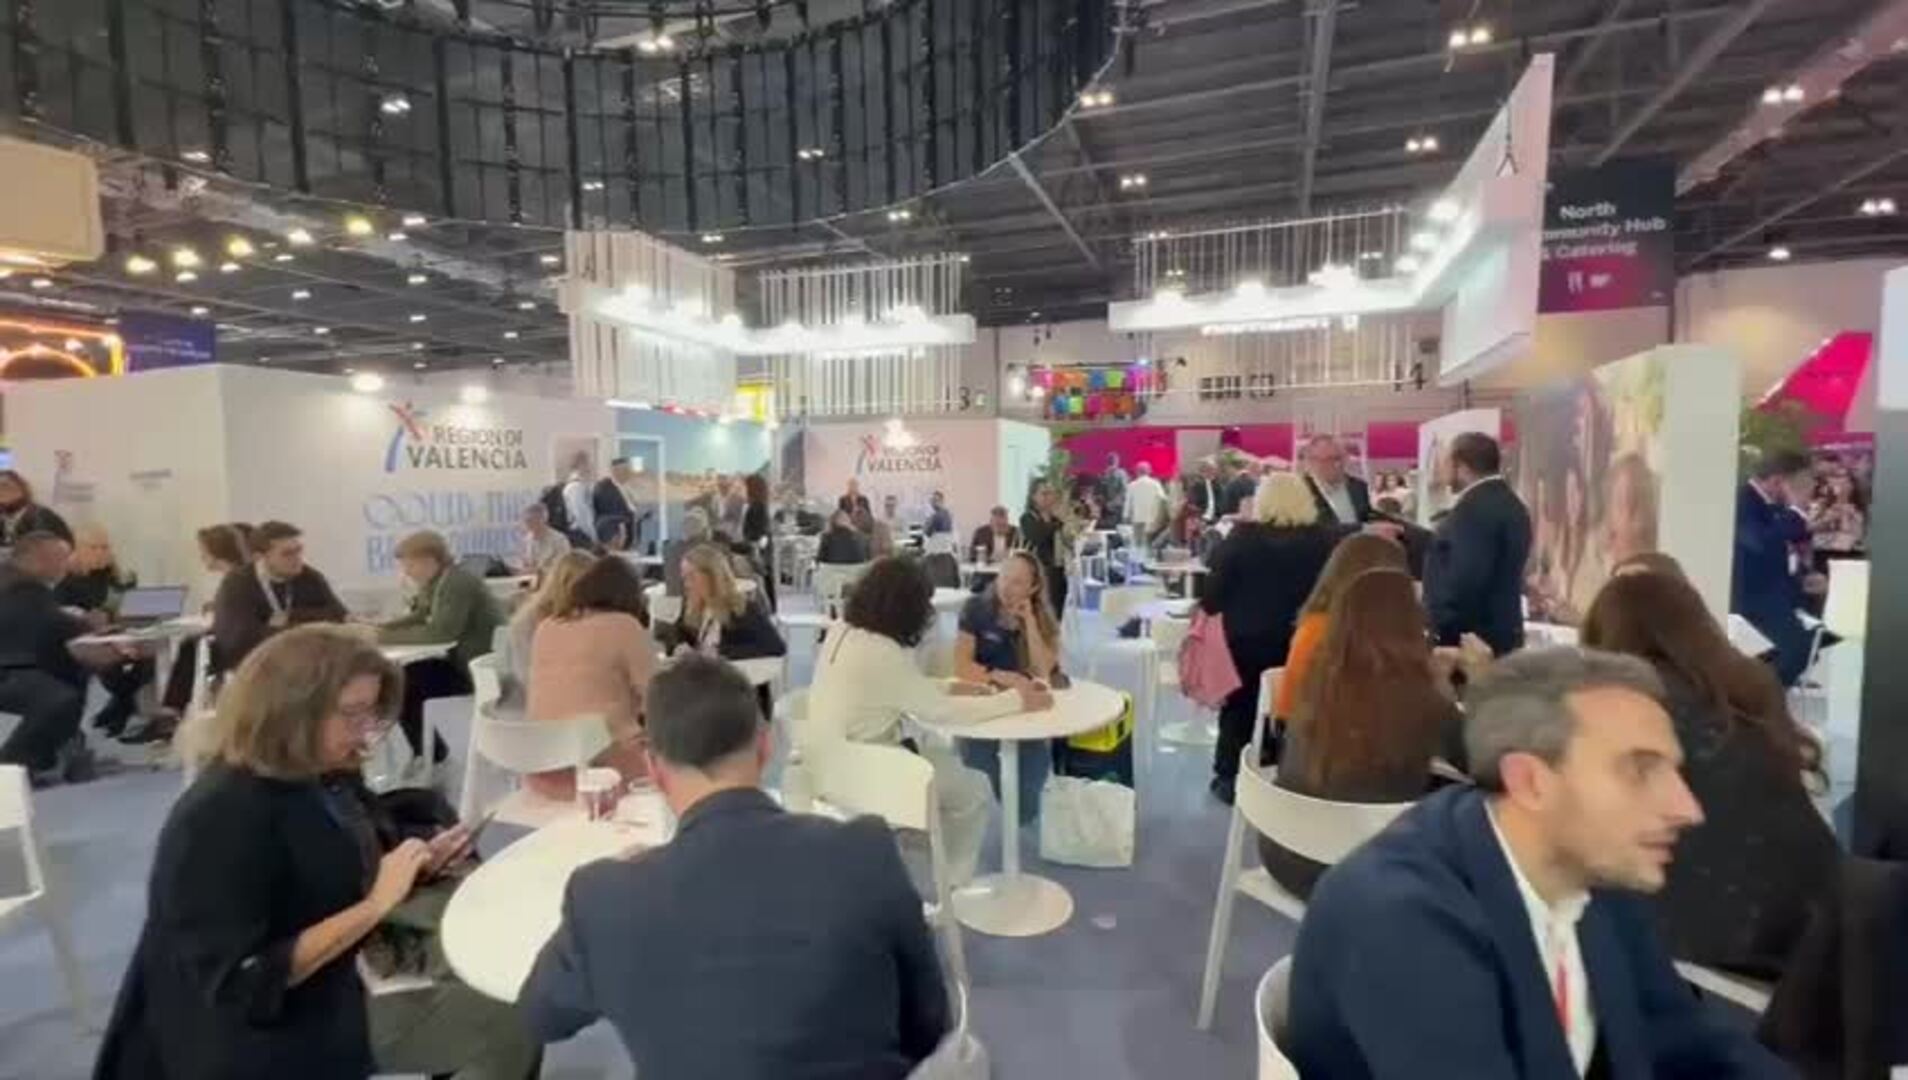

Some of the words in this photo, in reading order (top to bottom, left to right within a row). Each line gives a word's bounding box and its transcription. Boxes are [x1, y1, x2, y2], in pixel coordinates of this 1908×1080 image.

[1560, 202, 1616, 219] North
[1625, 216, 1667, 232] Hub
[406, 445, 527, 470] VALENCIA
[867, 457, 942, 473] VALENCIA
